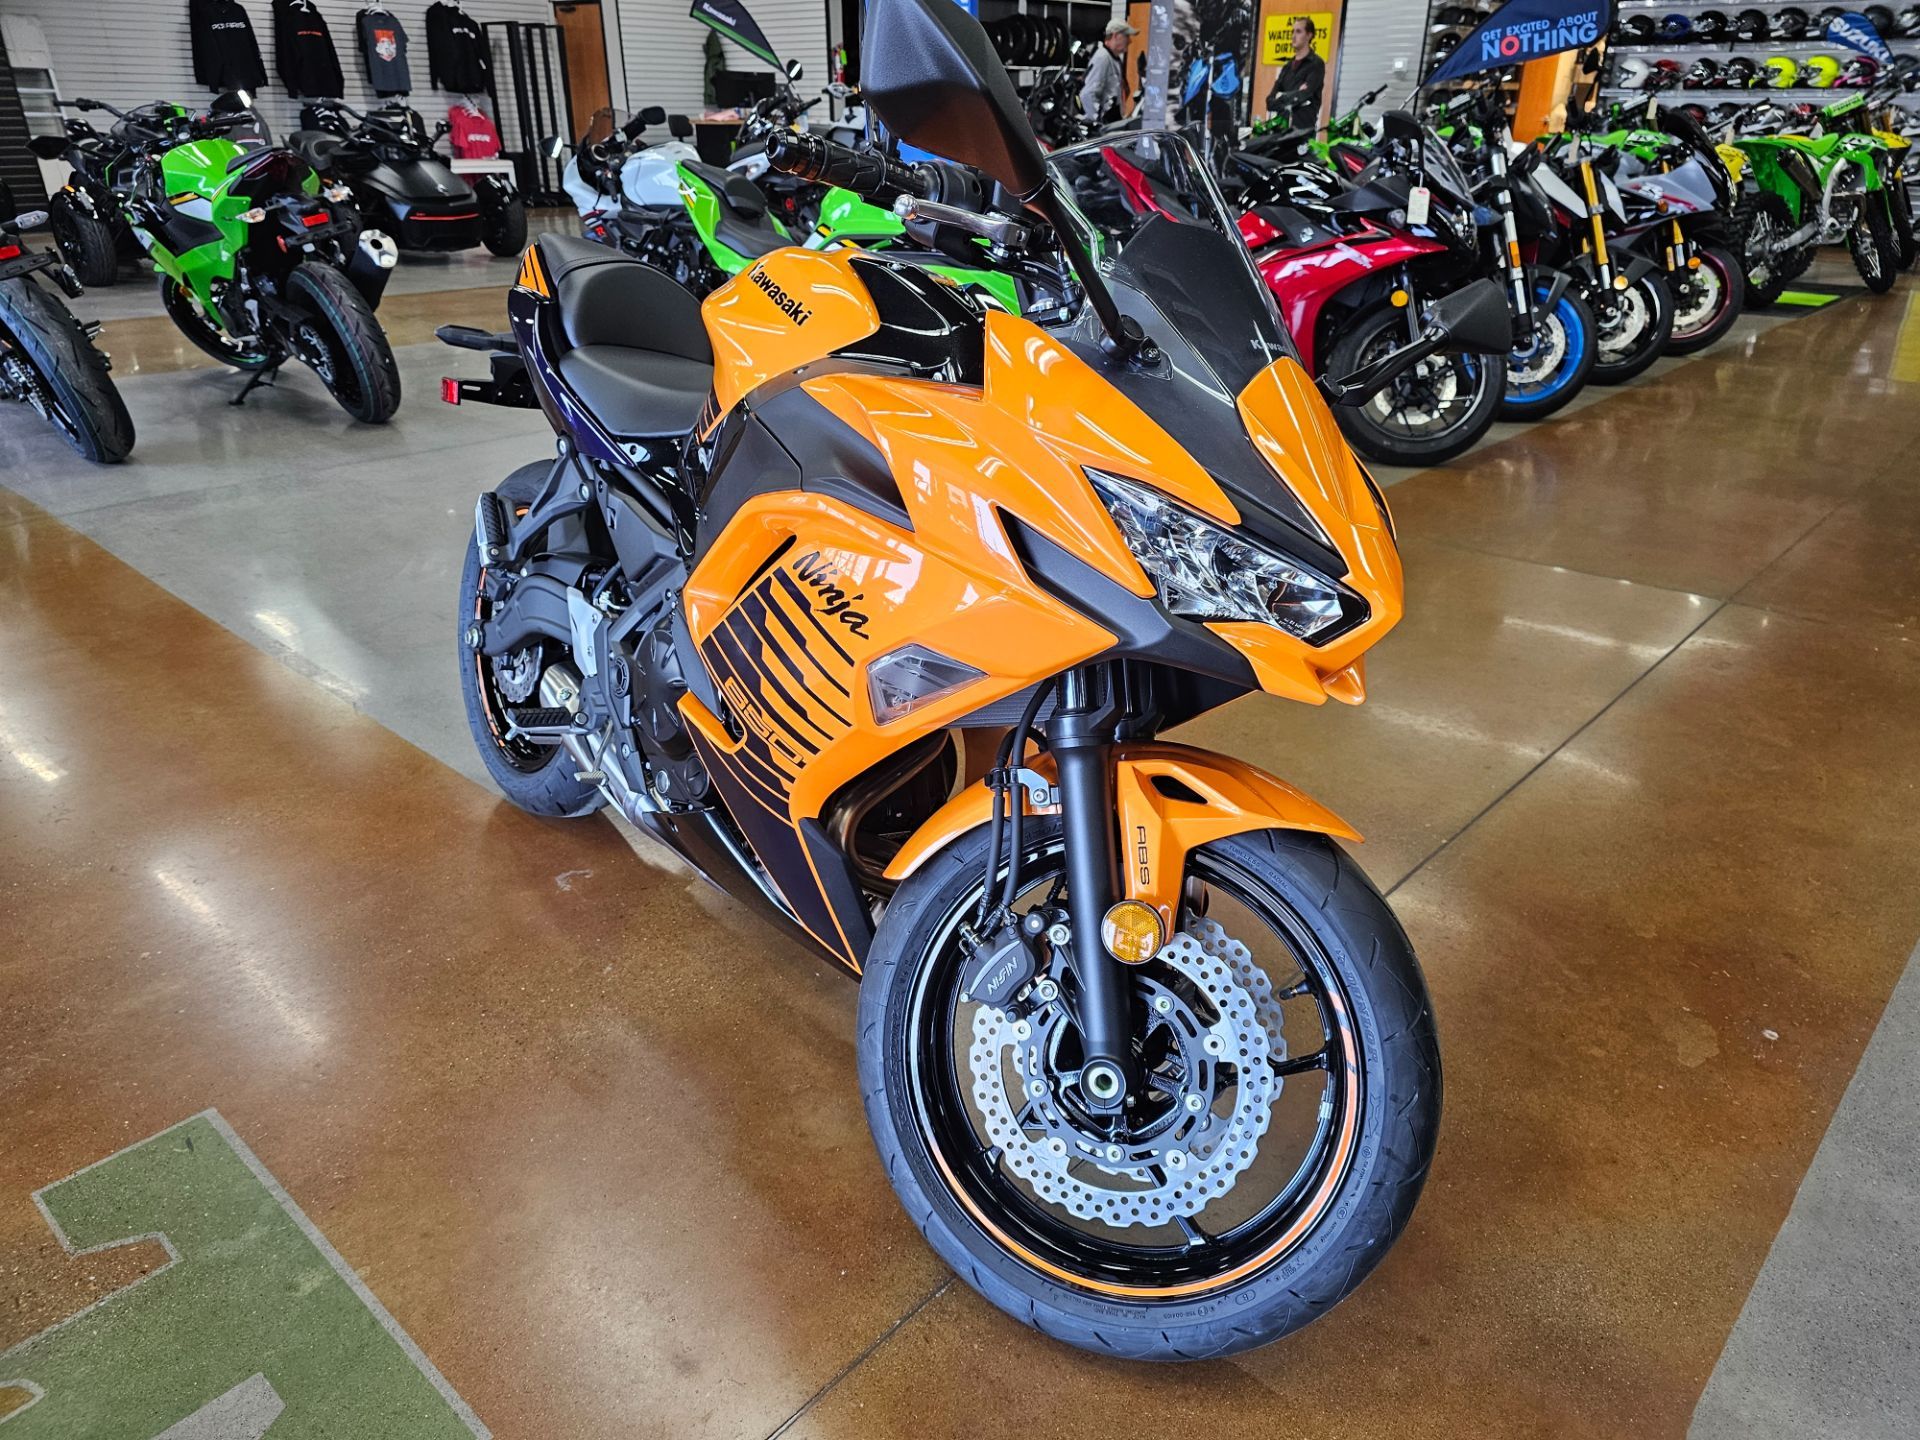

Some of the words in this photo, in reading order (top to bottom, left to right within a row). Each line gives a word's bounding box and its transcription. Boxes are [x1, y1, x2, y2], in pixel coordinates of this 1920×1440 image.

[1481, 29, 1502, 42] GET
[1506, 20, 1550, 36] EXCITED
[1557, 11, 1598, 29] ABOUT
[1481, 22, 1599, 61] NOTHING
[1829, 17, 1890, 61] SUZUKI
[793, 551, 870, 640] Ninja
[725, 676, 806, 767] 650
[1137, 825, 1150, 885] ABS
